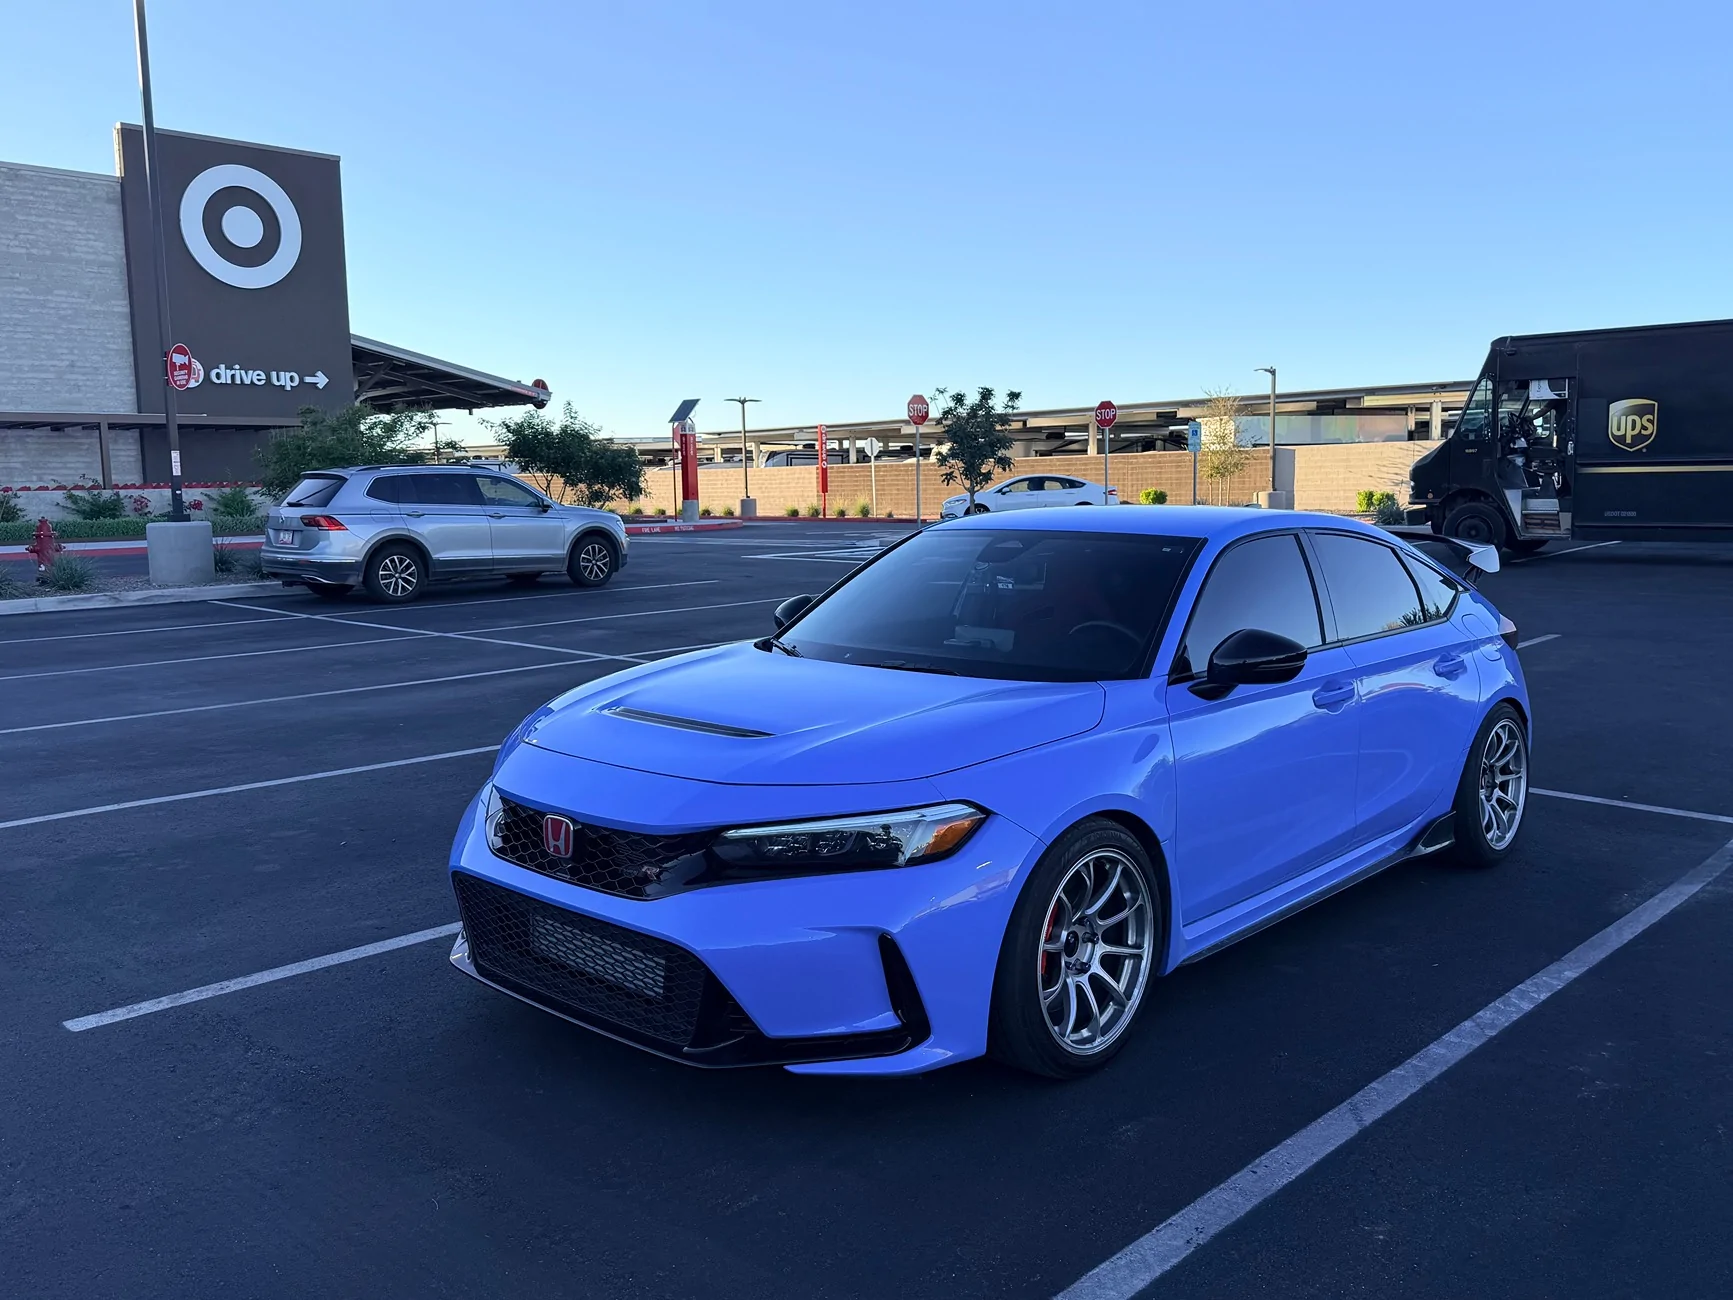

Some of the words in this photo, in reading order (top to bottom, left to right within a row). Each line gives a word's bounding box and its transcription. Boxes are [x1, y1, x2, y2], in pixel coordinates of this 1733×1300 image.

[209, 364, 267, 386] drive
[270, 371, 300, 391] up
[909, 404, 928, 416] STOP
[1096, 408, 1116, 420] STOP
[1612, 414, 1654, 444] ups
